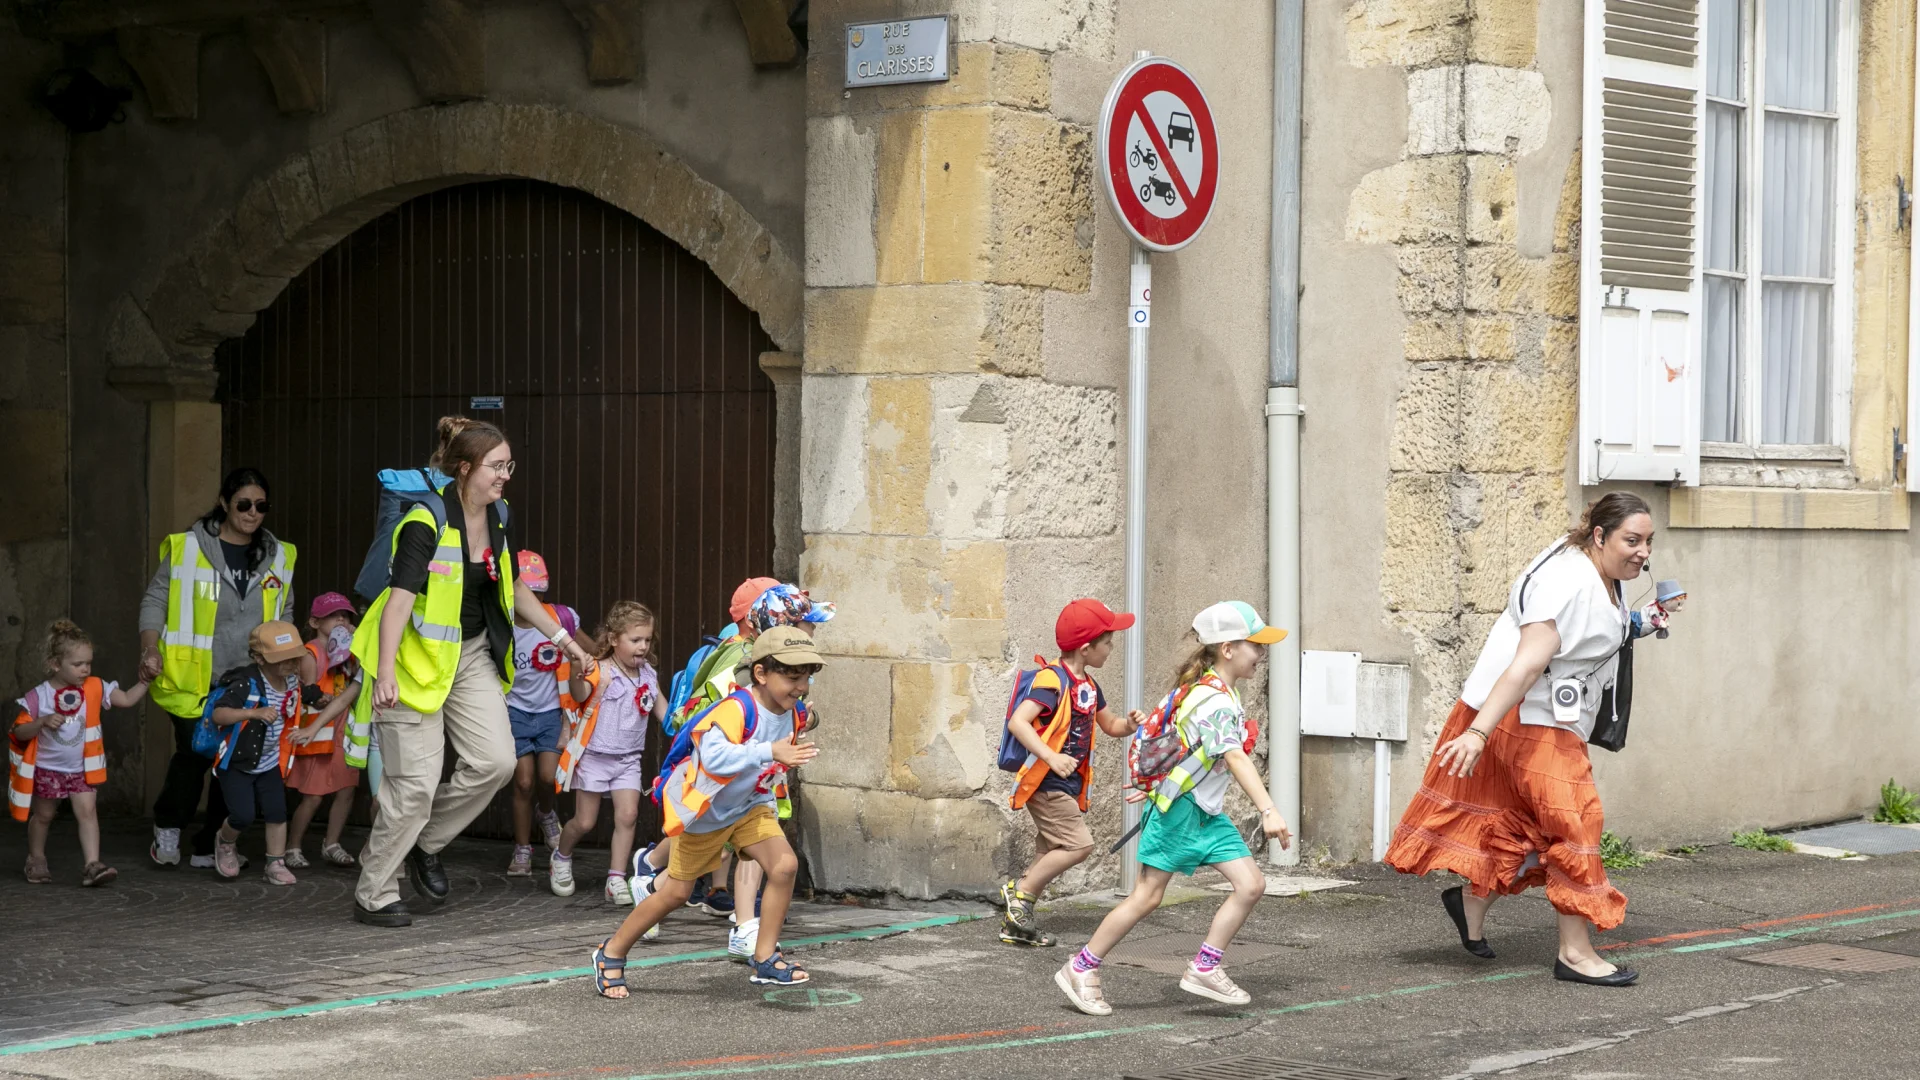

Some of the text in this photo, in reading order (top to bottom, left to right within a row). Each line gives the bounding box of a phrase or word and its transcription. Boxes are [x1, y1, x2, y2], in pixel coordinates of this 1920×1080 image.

[883, 23, 910, 39] RUE
[888, 44, 906, 55] DES
[857, 56, 934, 78] CLARISSES
